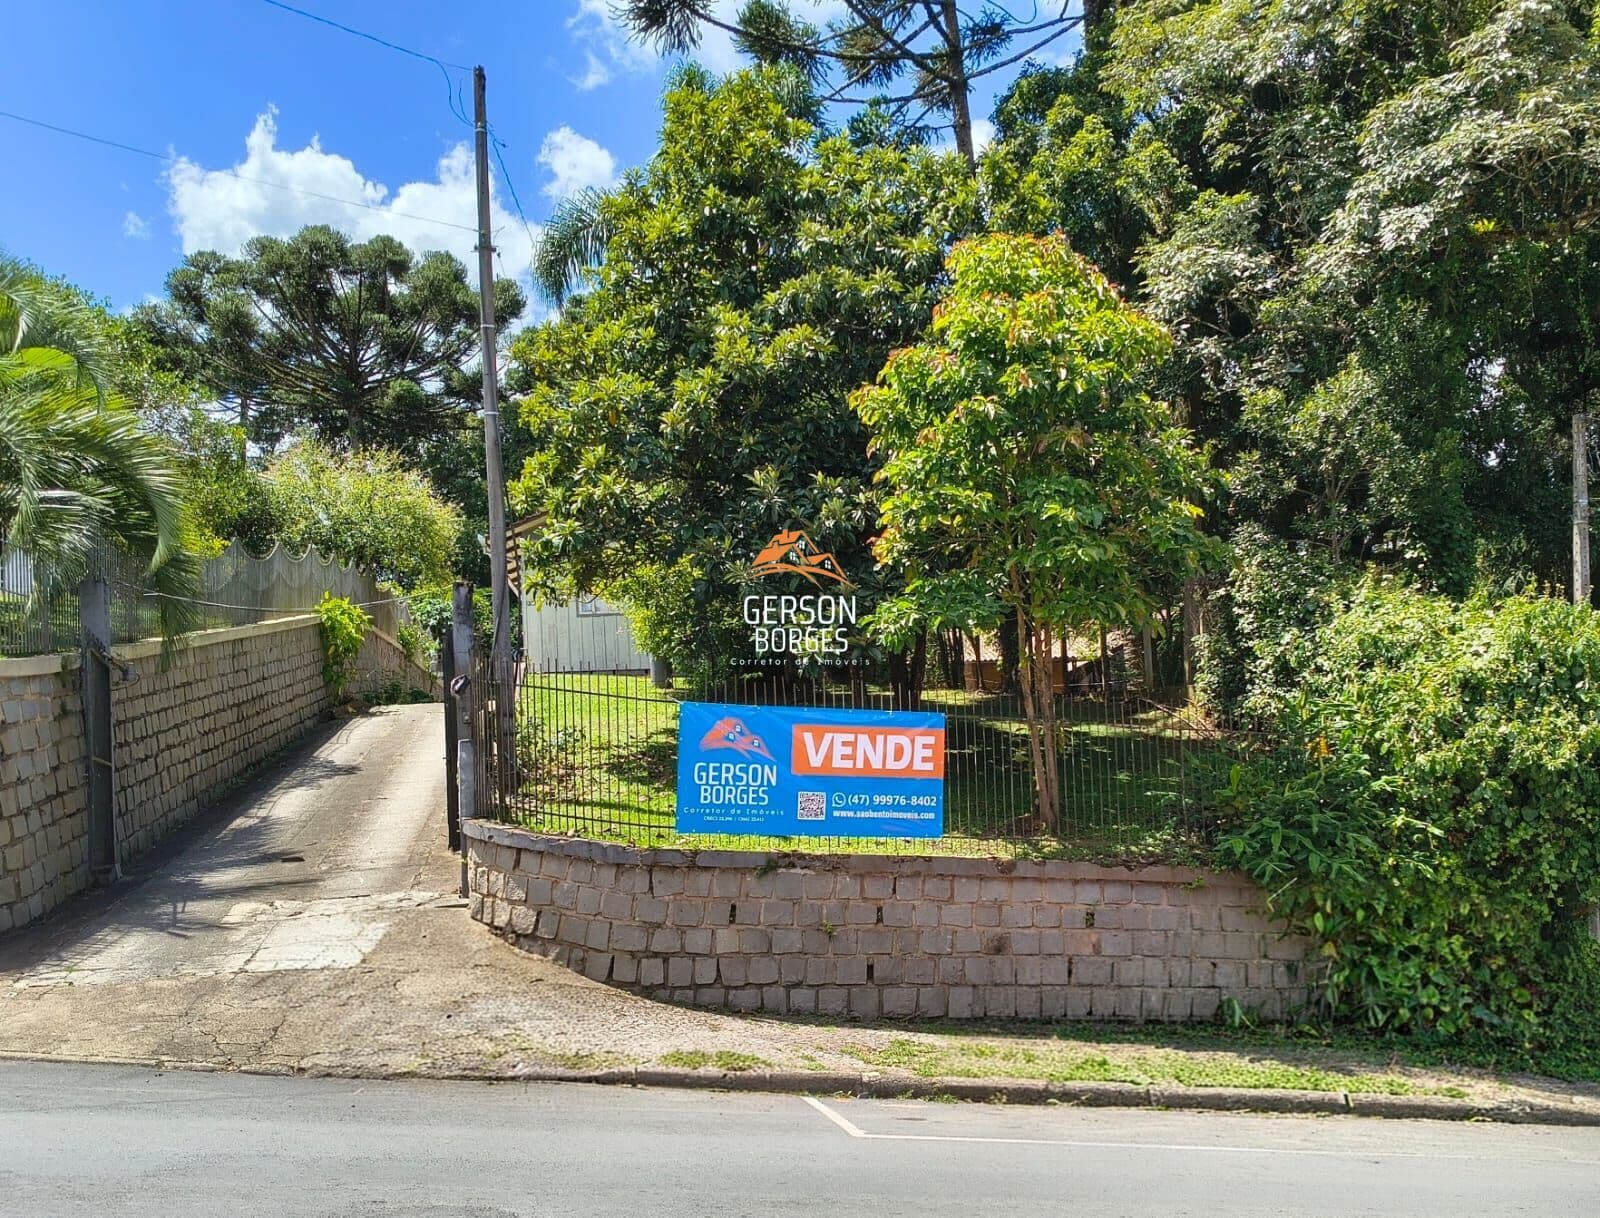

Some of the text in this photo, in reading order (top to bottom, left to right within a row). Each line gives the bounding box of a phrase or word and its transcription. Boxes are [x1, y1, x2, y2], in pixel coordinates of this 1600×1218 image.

[803, 732, 936, 771] VENDE
[694, 762, 777, 786] GERSON
[700, 785, 769, 806] BORGES
[848, 794, 937, 807] (47) 99976-8402
[832, 809, 936, 820] www.saobentoimoveis.com
